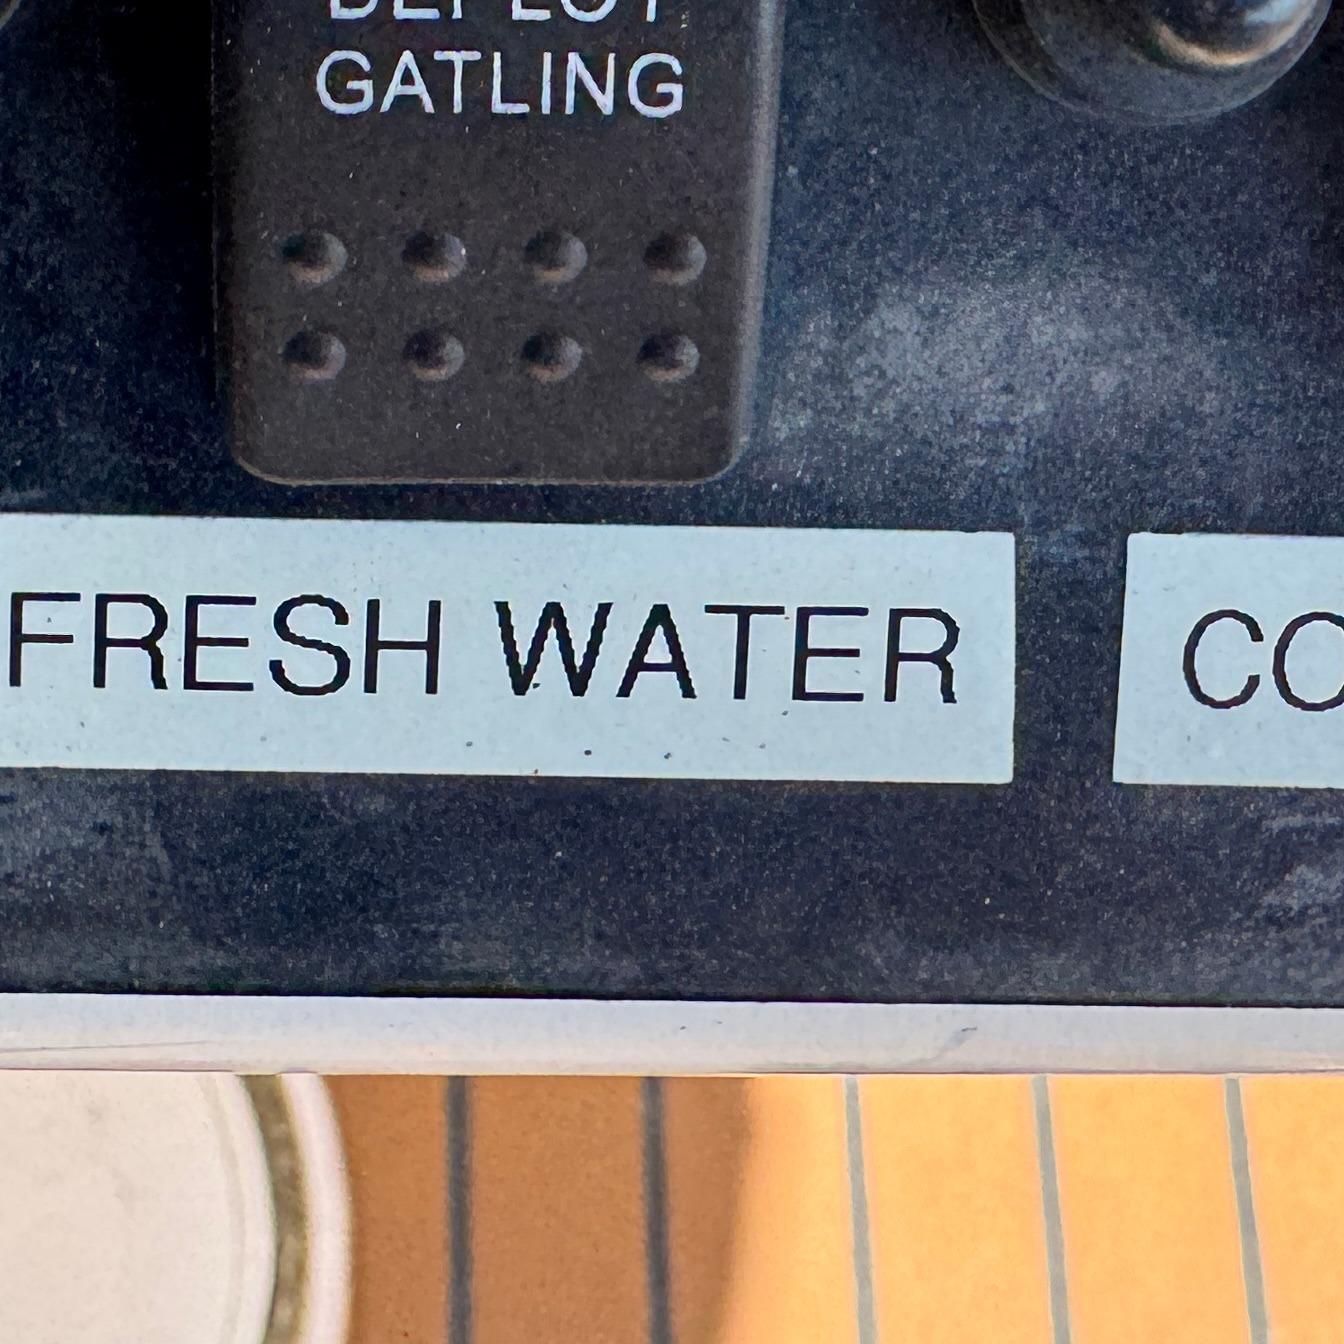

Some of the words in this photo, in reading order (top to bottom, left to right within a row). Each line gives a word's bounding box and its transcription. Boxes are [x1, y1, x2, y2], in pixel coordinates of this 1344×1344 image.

[316, 50, 684, 118] GATLING
[8, 591, 443, 696] FRESH
[494, 601, 960, 704] WATER
